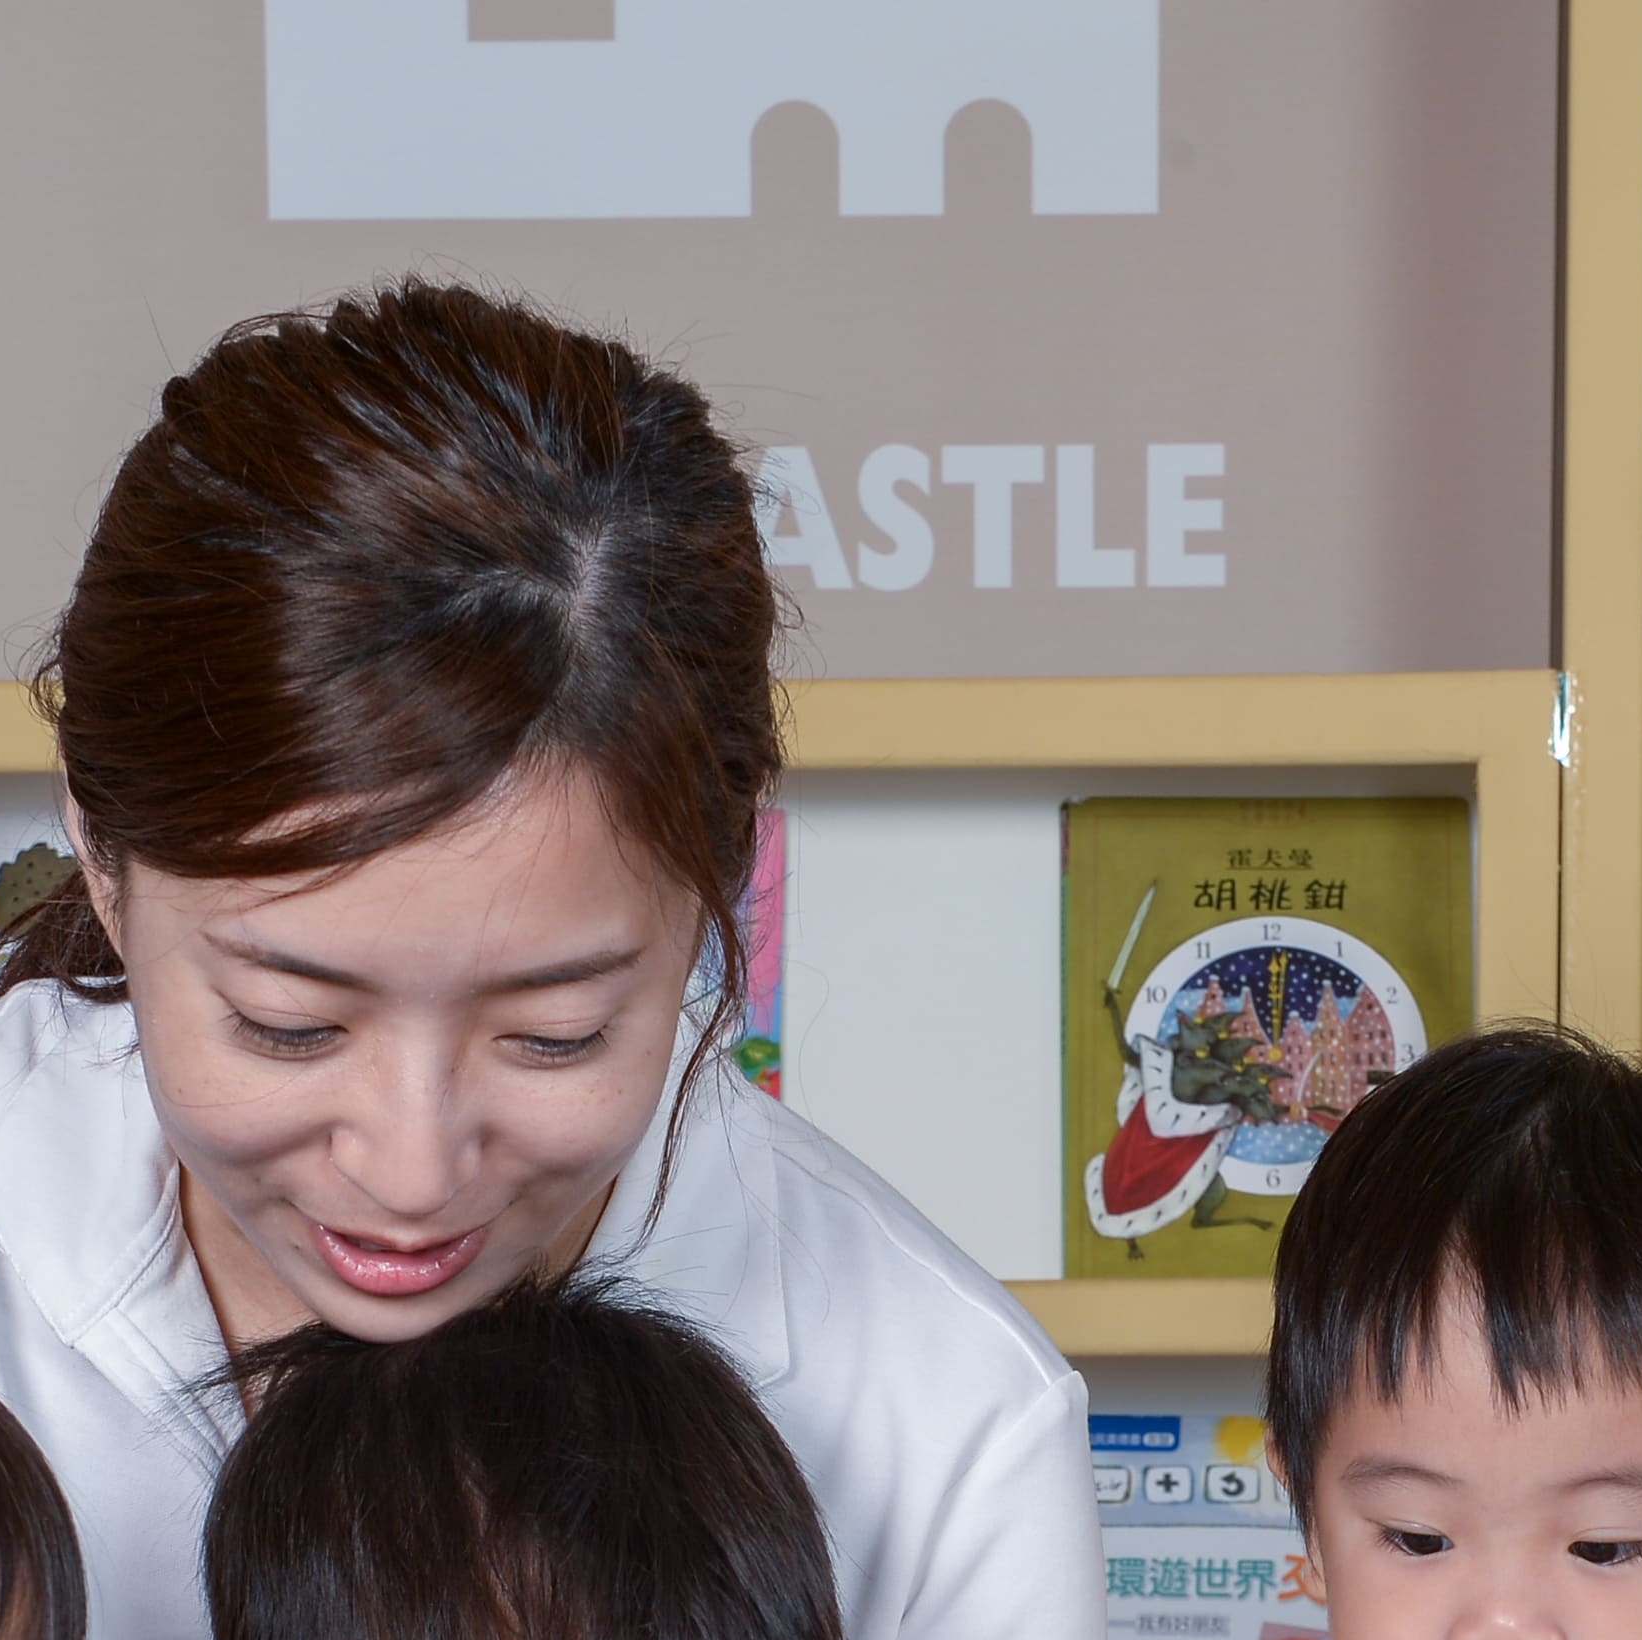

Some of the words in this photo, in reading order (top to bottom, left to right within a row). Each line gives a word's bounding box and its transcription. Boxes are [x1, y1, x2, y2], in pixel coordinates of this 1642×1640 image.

[753, 444, 1226, 591] ASTLE
[1193, 877, 1348, 911] 胡桃鉗
[1262, 923, 1282, 941] 12
[1195, 941, 1211, 959] 11
[1335, 941, 1344, 958] 1
[1145, 986, 1167, 1004] 10
[1386, 987, 1398, 1005] 2
[1400, 1044, 1415, 1064] 3
[1266, 1169, 1281, 1188] 6
